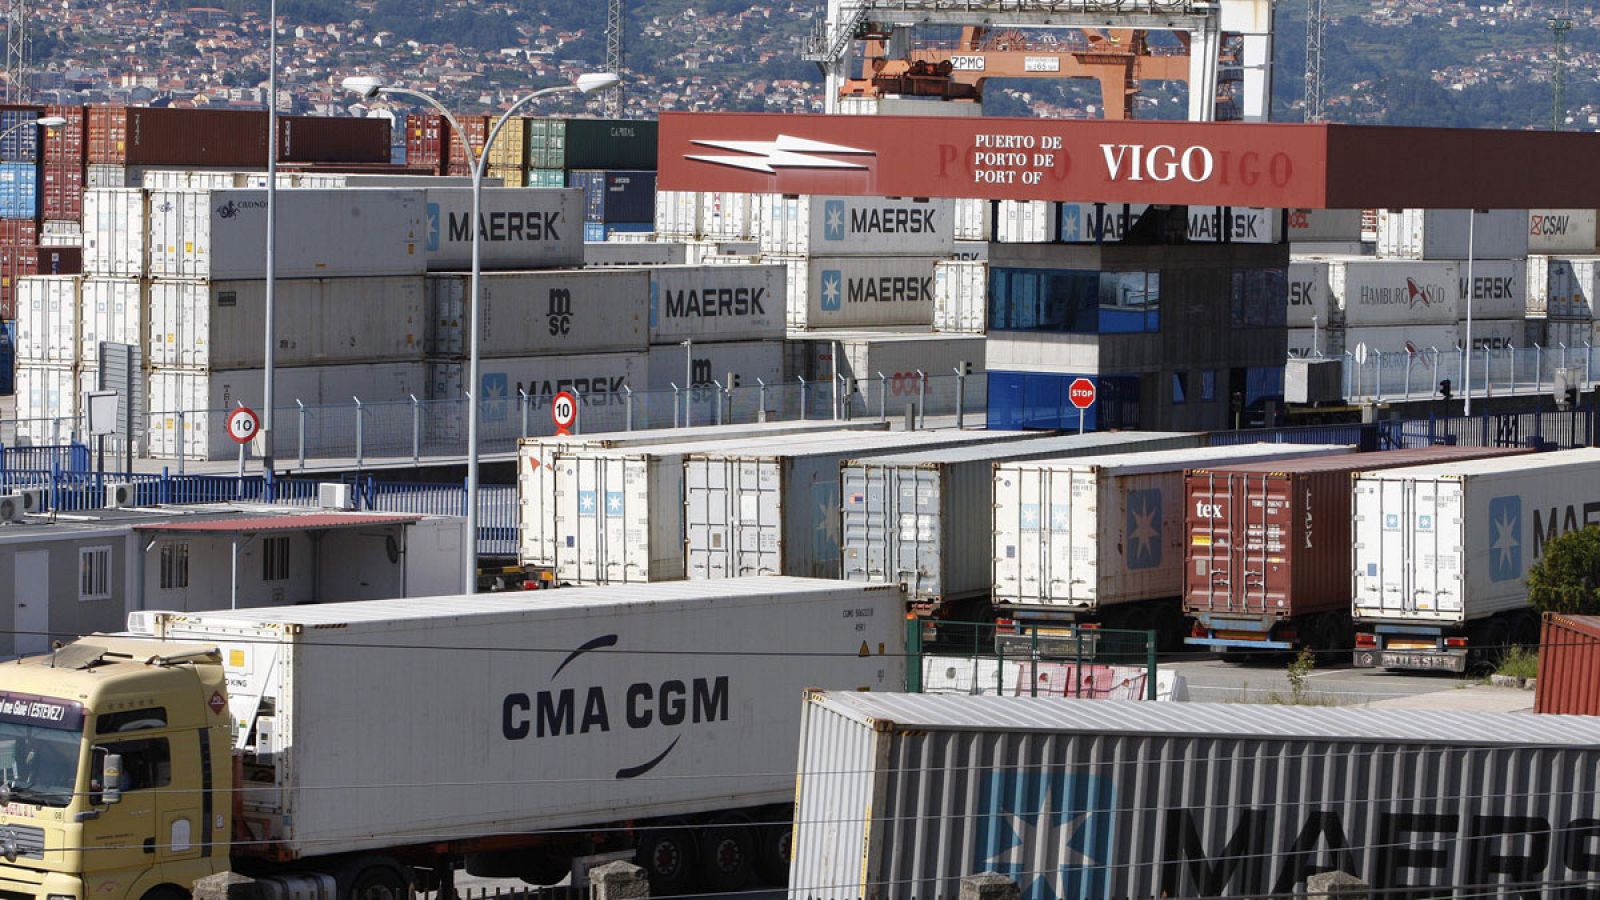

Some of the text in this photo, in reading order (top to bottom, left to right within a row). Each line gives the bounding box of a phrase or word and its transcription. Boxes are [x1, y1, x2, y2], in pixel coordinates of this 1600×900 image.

[951, 56, 984, 69] ZPMC
[975, 134, 1062, 149] PUERTO DE
[975, 151, 1054, 168] PORTO DE
[1099, 143, 1214, 183] VIGO
[975, 169, 1043, 185] PORT OF
[237, 201, 268, 209] CRONO
[448, 210, 561, 243] MAERSK
[851, 207, 936, 233] MAERSK
[1542, 216, 1569, 236] CSAV
[847, 276, 933, 303] MAERSK
[1360, 284, 1445, 306] HAMBURG SÜD
[665, 287, 766, 318] MAERSK
[1072, 389, 1093, 397] STOP
[556, 403, 570, 418] 10
[235, 419, 252, 431] 10
[1196, 499, 1223, 518] tex
[230, 679, 248, 688] KING
[502, 676, 729, 741] CMA CGM
